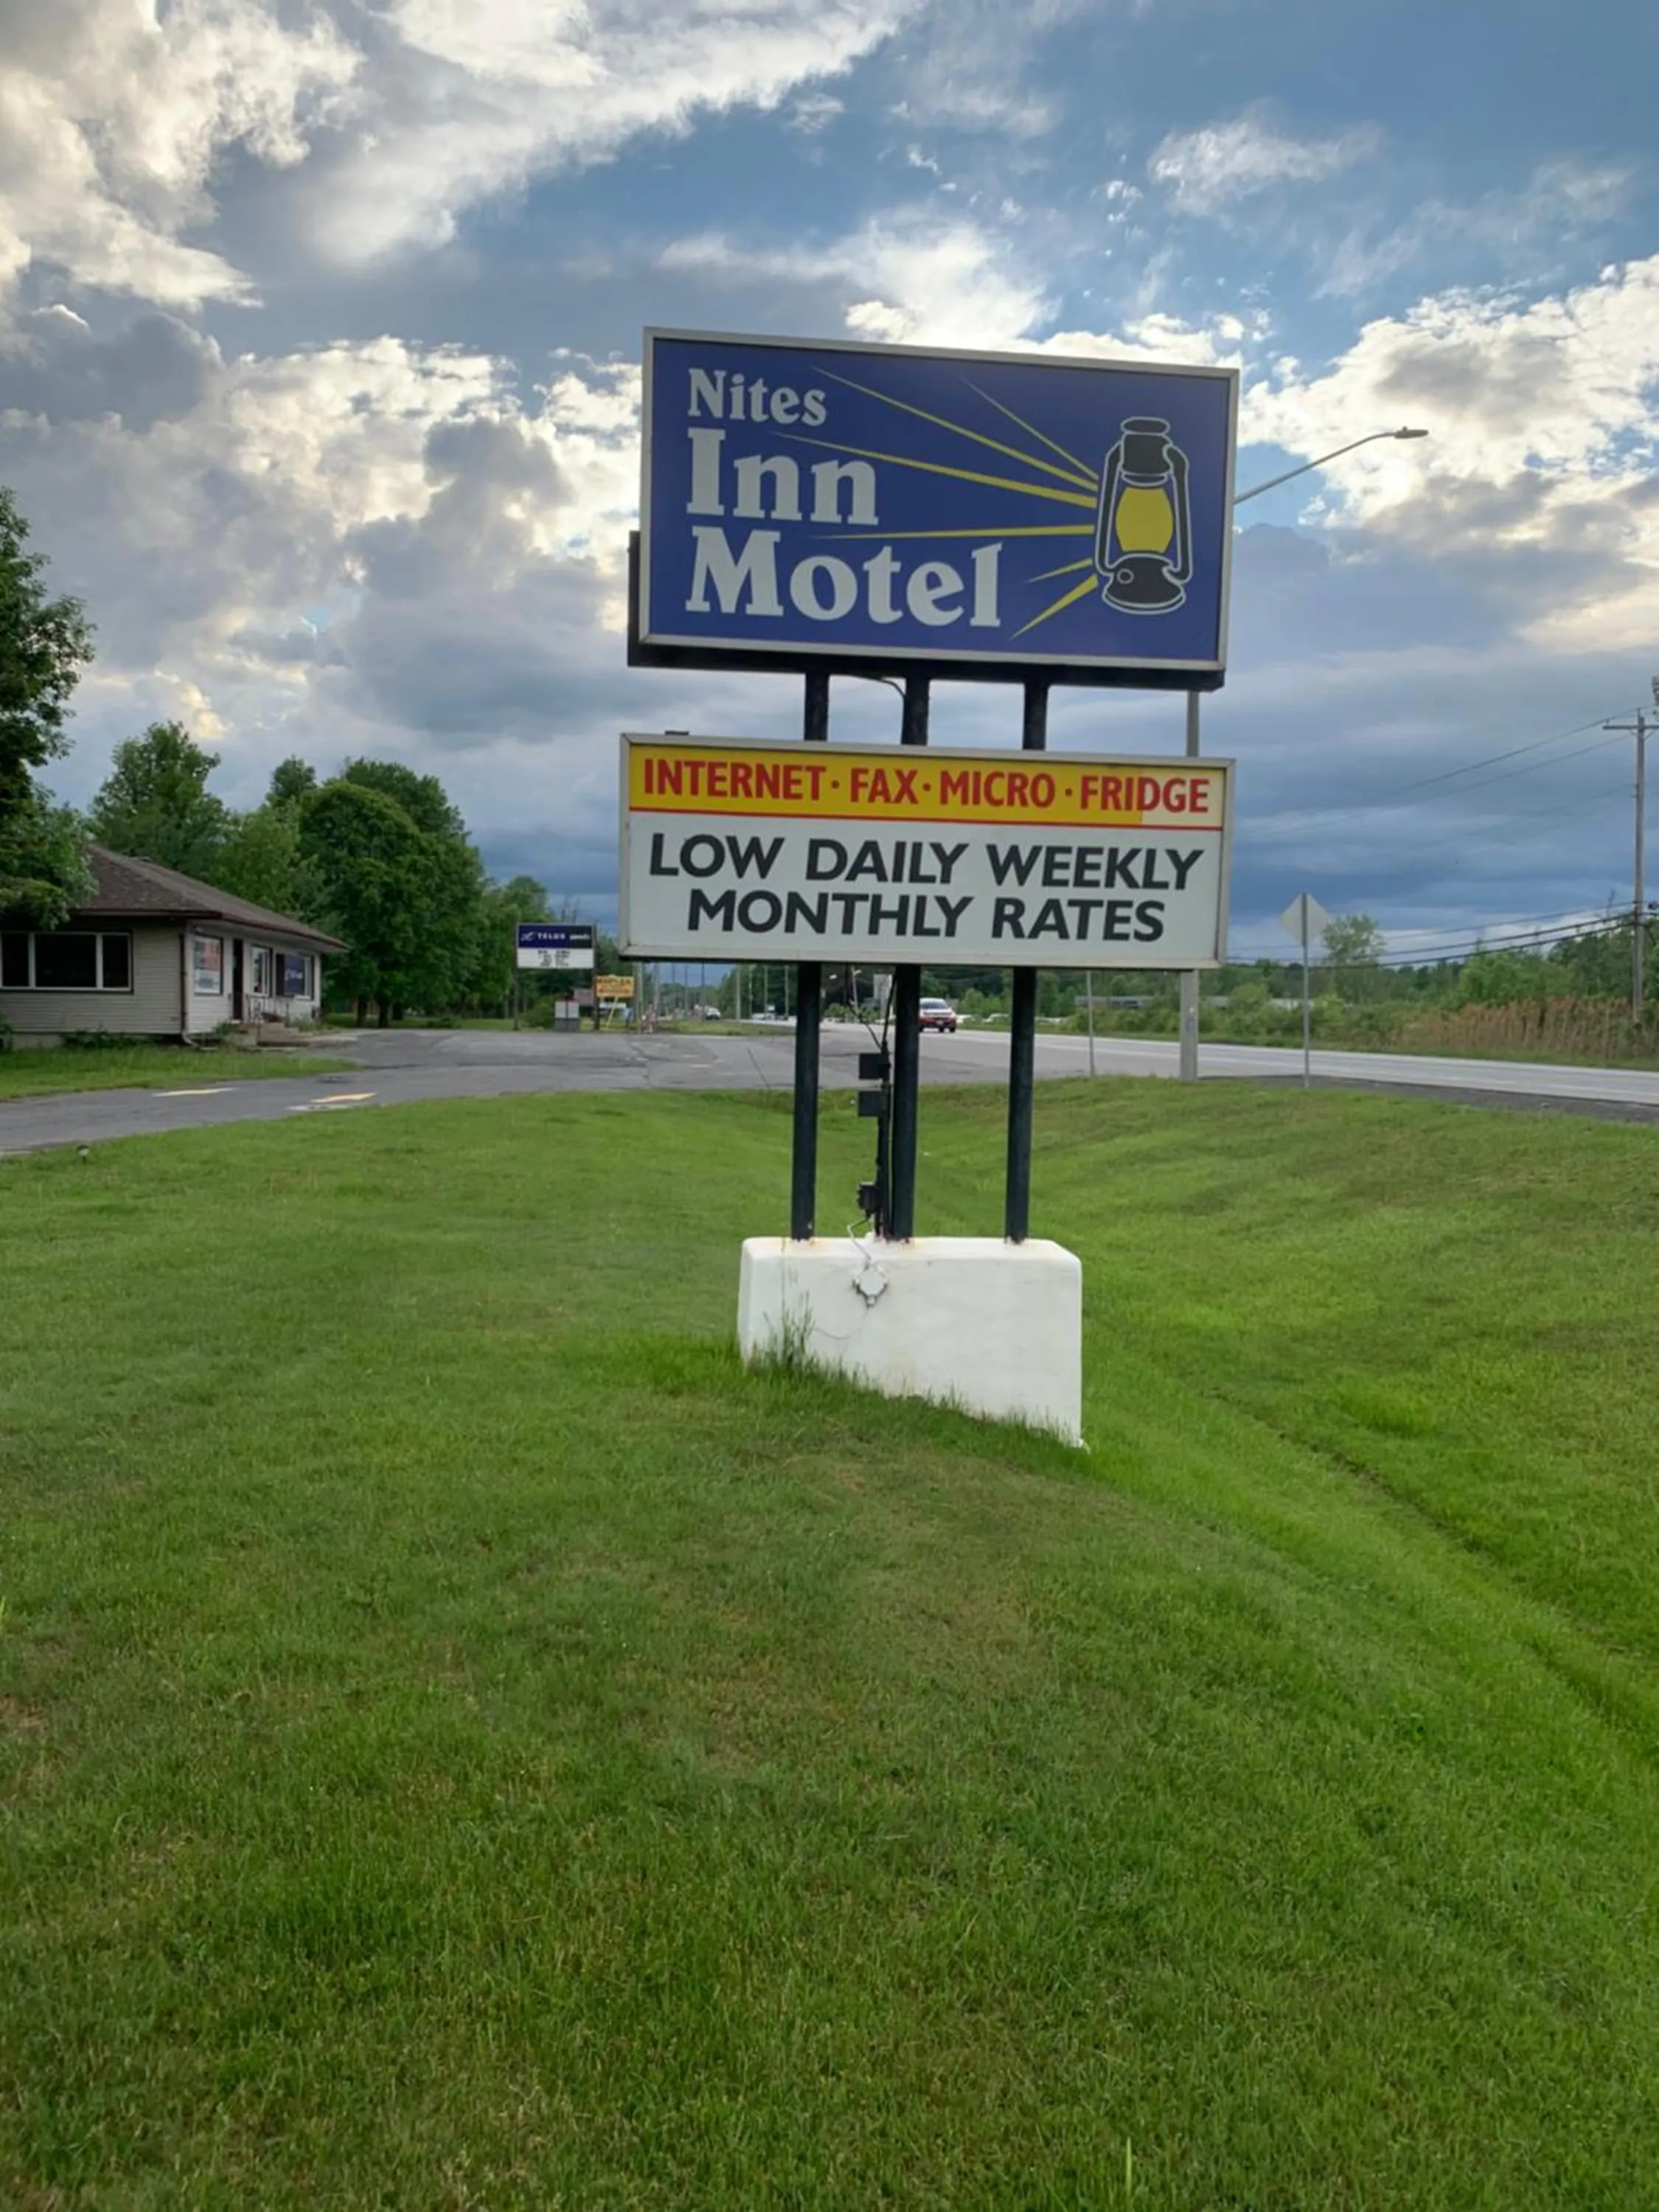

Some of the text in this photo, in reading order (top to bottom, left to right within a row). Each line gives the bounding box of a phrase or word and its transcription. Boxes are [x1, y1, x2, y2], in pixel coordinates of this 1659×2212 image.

[688, 368, 827, 426] Nites
[686, 428, 879, 526] Inn
[686, 526, 1003, 627] Motel
[643, 758, 1209, 814] INTERNET FAX MICRO FRIDGE
[649, 832, 1205, 891] LOW DAILY WEEKLY
[687, 888, 1165, 942] MONTHLY RATES
